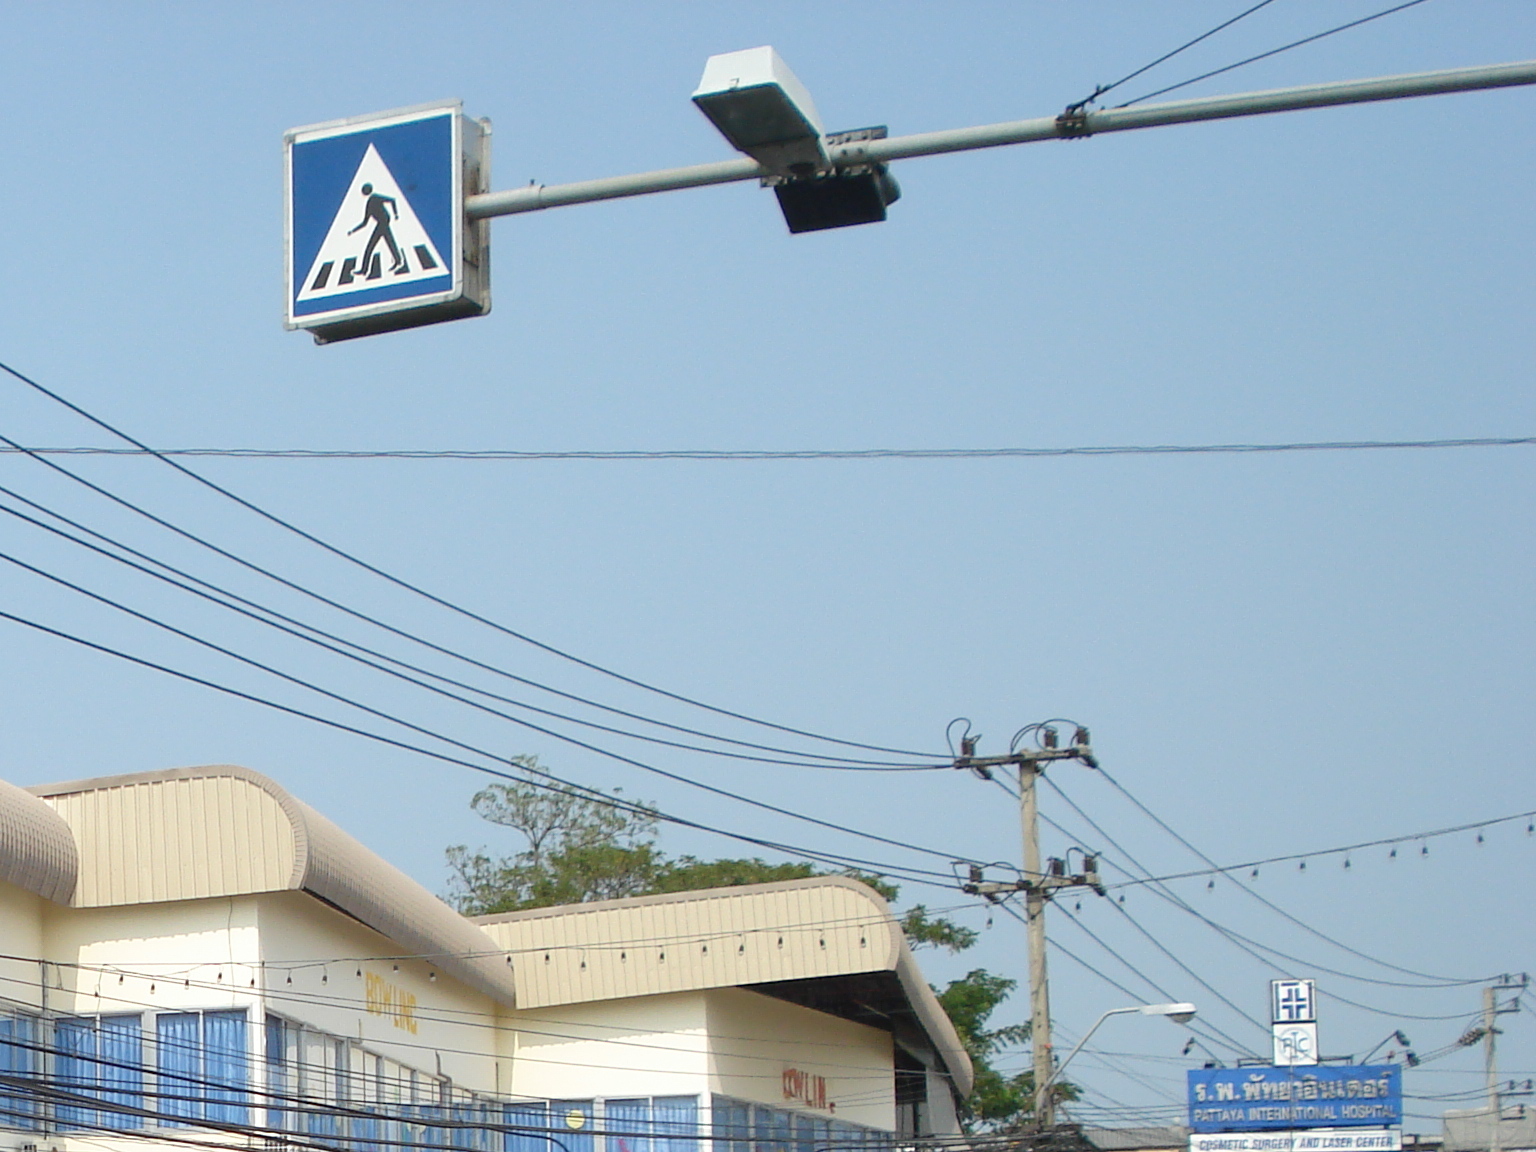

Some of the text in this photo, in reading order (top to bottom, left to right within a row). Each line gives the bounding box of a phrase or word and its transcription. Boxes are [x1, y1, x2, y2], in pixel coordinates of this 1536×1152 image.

[1194, 1103, 1397, 1122] PATTAYA INTERNATIONAL HOSPITAL
[1200, 1136, 1394, 1151] COSMETIC SURGERY AND LASER CENTER
